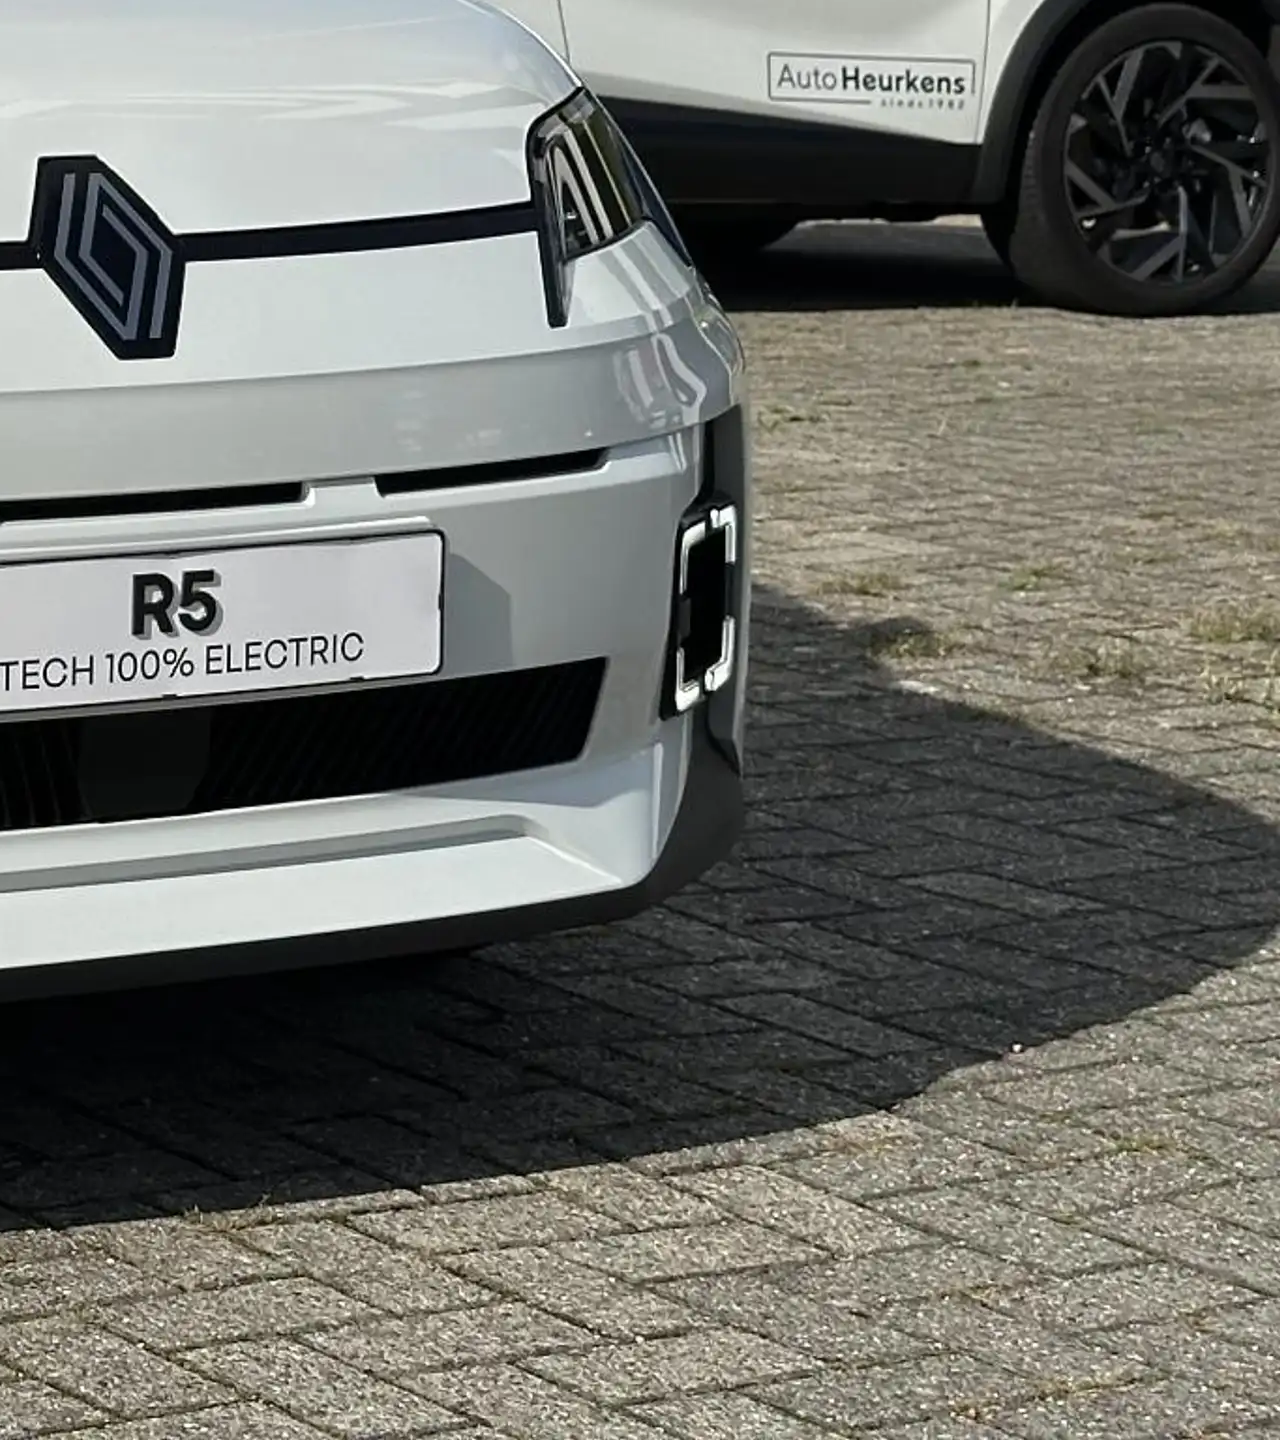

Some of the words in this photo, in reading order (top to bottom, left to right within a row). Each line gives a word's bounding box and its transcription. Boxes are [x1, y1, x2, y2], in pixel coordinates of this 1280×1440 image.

[777, 63, 837, 91] Auto
[841, 65, 966, 95] Heurkens
[131, 569, 224, 639] R5
[106, 646, 195, 683] 100%
[205, 632, 365, 674] ELECTRIC
